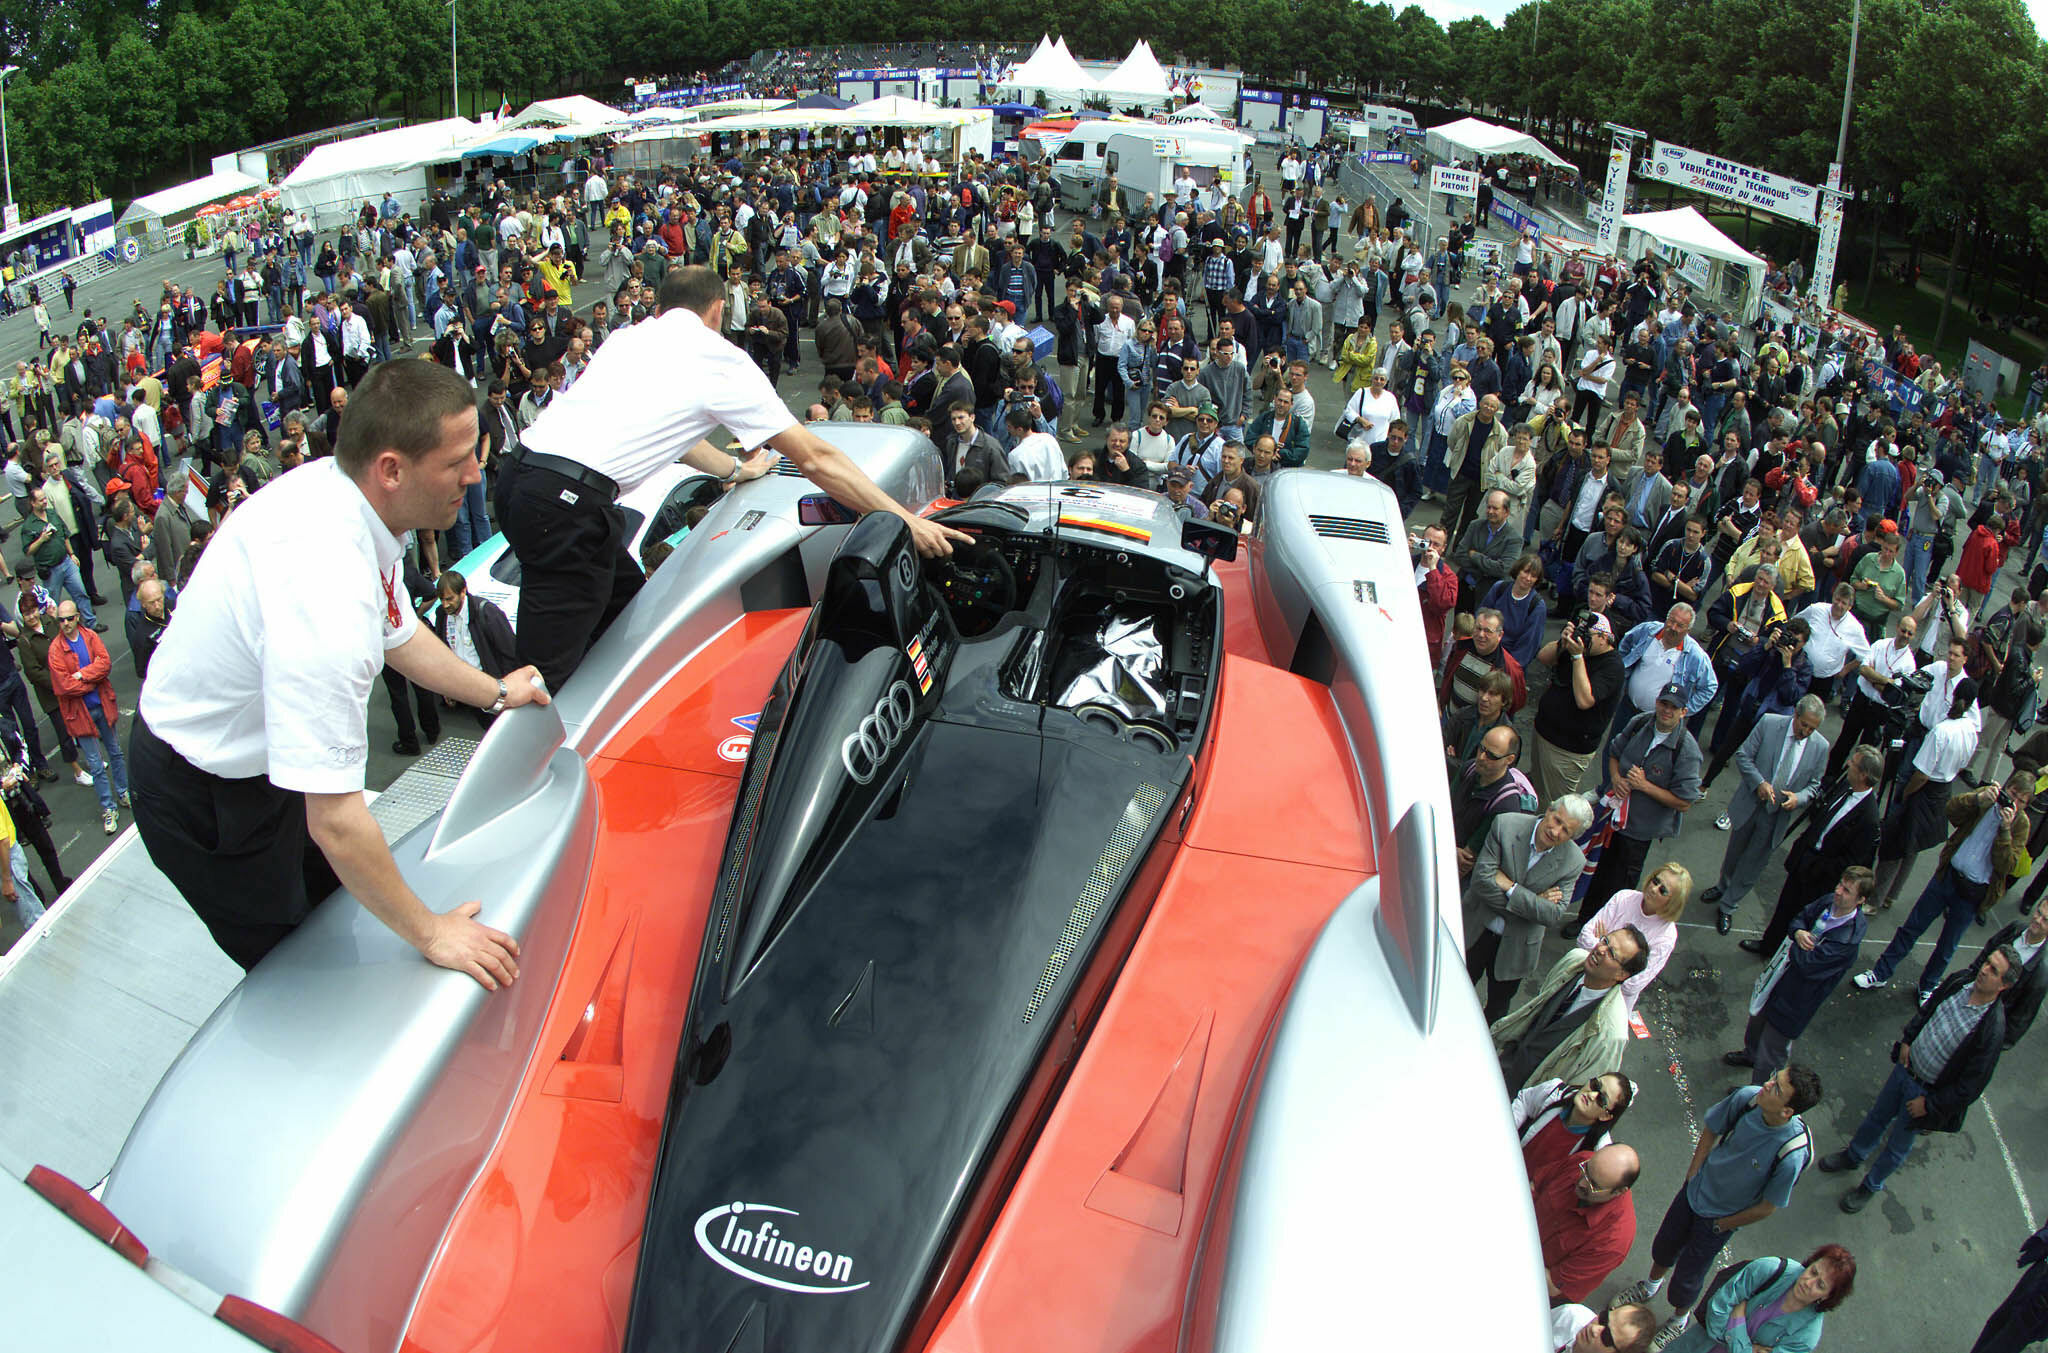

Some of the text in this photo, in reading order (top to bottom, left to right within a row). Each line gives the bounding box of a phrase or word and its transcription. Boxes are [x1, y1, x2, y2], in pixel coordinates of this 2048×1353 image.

[1242, 89, 1258, 98] MANS
[1679, 161, 1738, 185] VERIFICATIONS
[1745, 180, 1790, 201] TECHNIQUES
[1828, 169, 1839, 179] 24
[1440, 181, 1470, 192] PIETONS
[1738, 190, 1749, 199] DU
[1752, 194, 1775, 207] MANS
[1604, 199, 1615, 213] DU
[1866, 362, 1884, 387] 24
